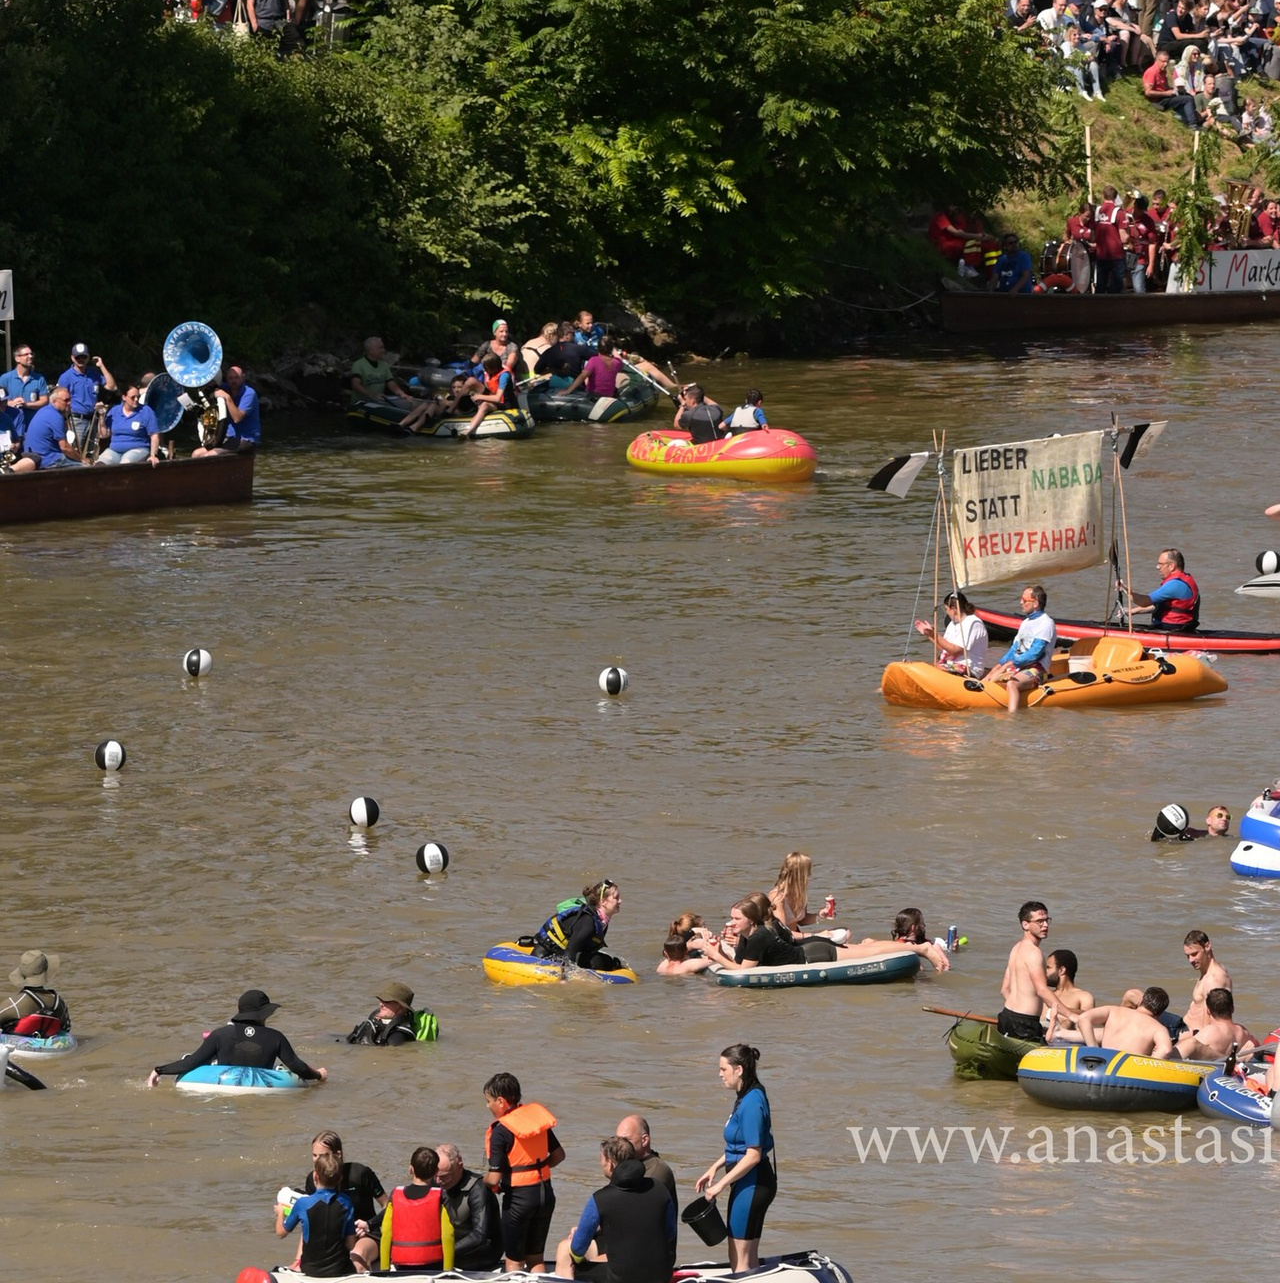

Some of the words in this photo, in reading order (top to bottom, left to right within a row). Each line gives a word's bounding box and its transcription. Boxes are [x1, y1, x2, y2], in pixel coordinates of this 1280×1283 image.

[962, 447, 1028, 475] LIEBER
[1031, 461, 1103, 491] NABADA
[965, 494, 1021, 523] STATT
